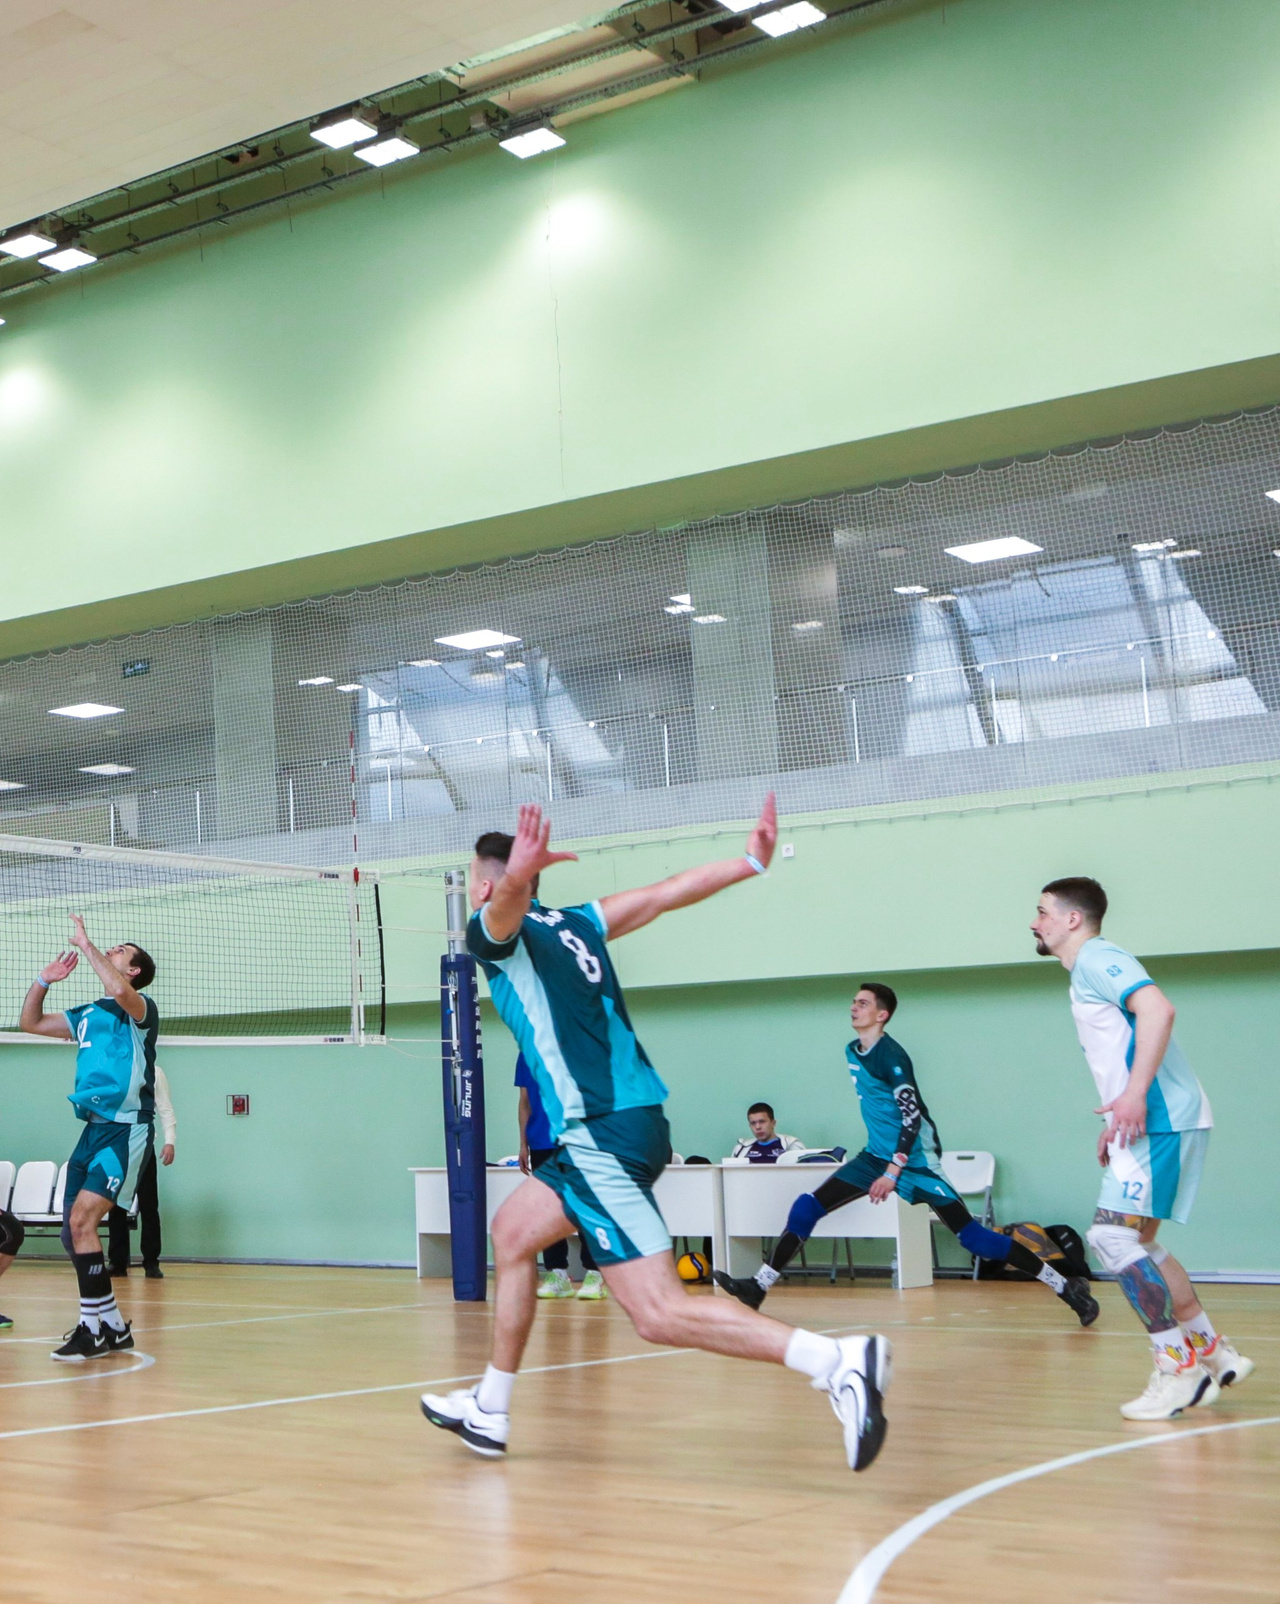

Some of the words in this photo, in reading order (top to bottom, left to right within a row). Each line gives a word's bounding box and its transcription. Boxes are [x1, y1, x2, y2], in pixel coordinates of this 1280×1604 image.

[558, 929, 602, 984] 8
[107, 1176, 120, 1193] 12
[935, 1185, 946, 1197] 1
[1122, 1180, 1143, 1201] 12
[595, 1226, 611, 1251] 8
